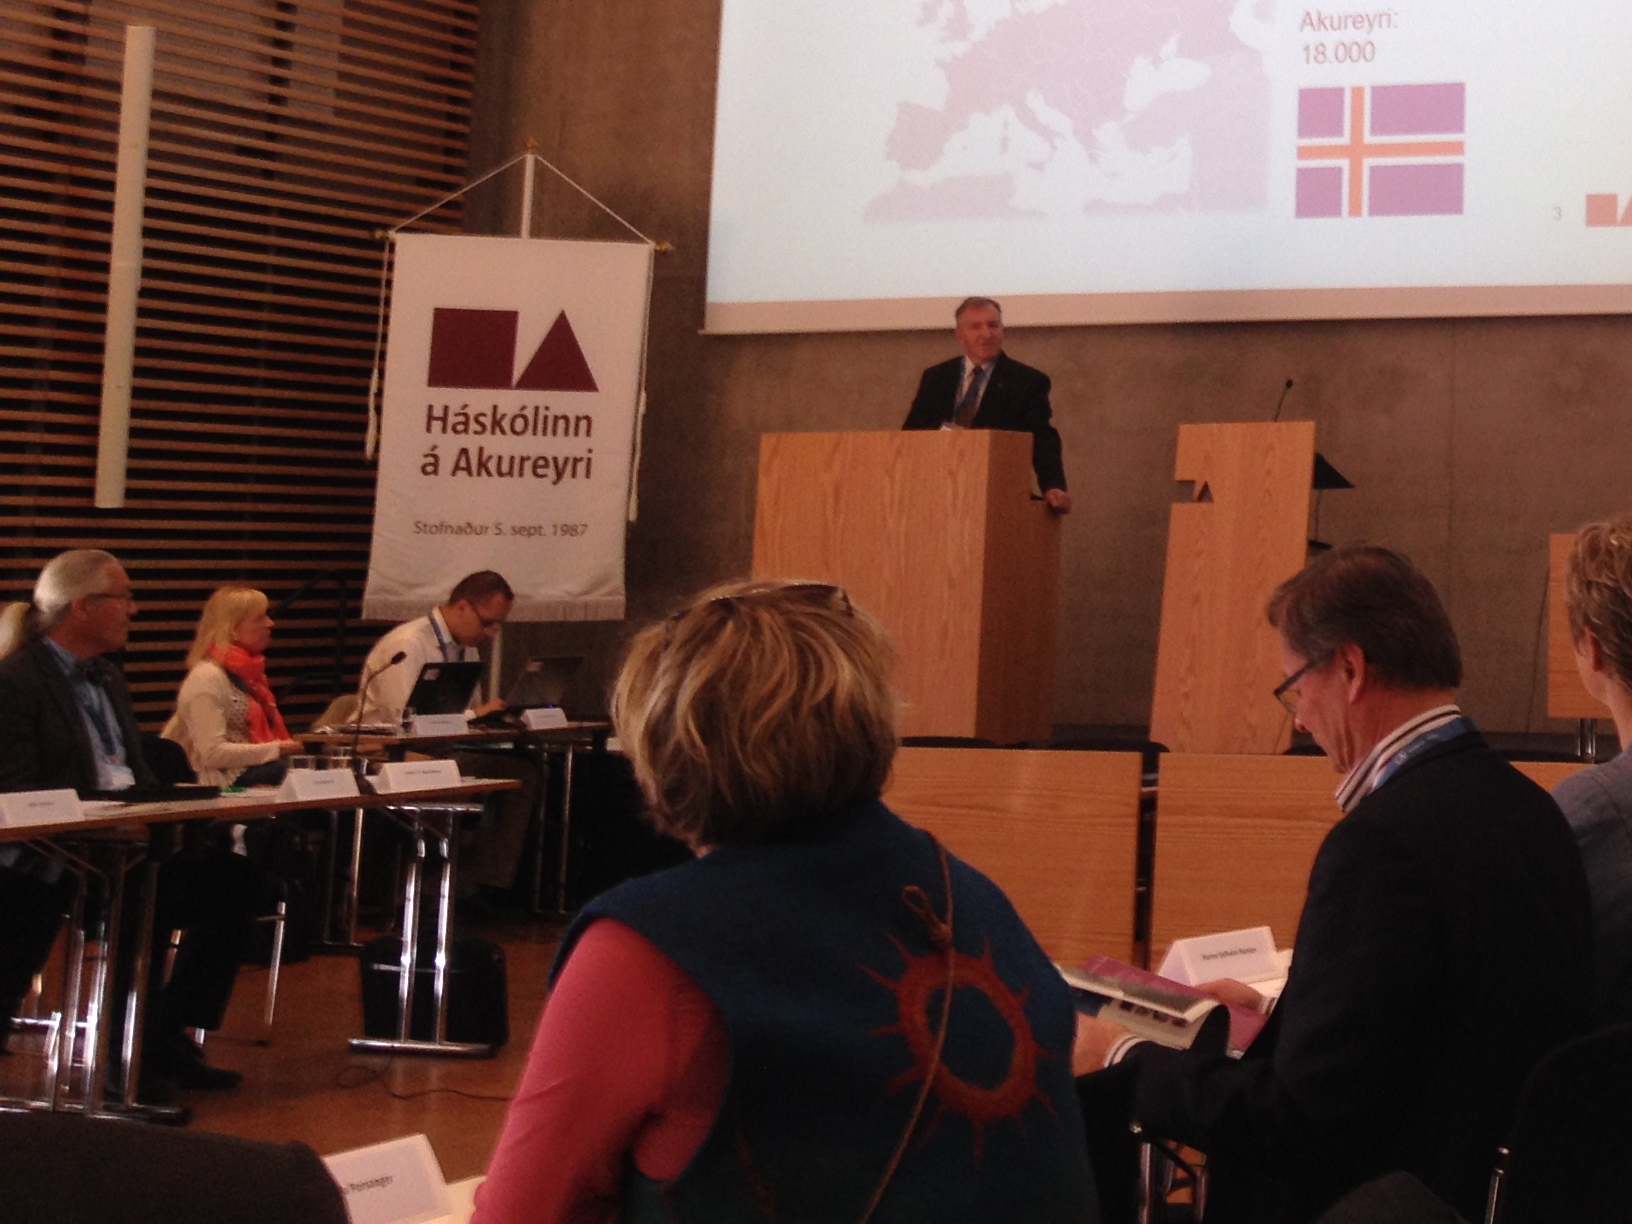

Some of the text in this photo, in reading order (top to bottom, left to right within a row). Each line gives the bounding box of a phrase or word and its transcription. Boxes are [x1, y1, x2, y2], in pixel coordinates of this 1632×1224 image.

[1299, 7, 1398, 35] Akureyri:
[1303, 40, 1376, 65] 18.000
[1552, 203, 1563, 221] 3
[425, 403, 593, 438] Háskólinn
[420, 444, 594, 486] á Akureyri
[413, 520, 489, 537] Stofnaður
[511, 523, 547, 539] sept.
[552, 523, 588, 538] 1987
